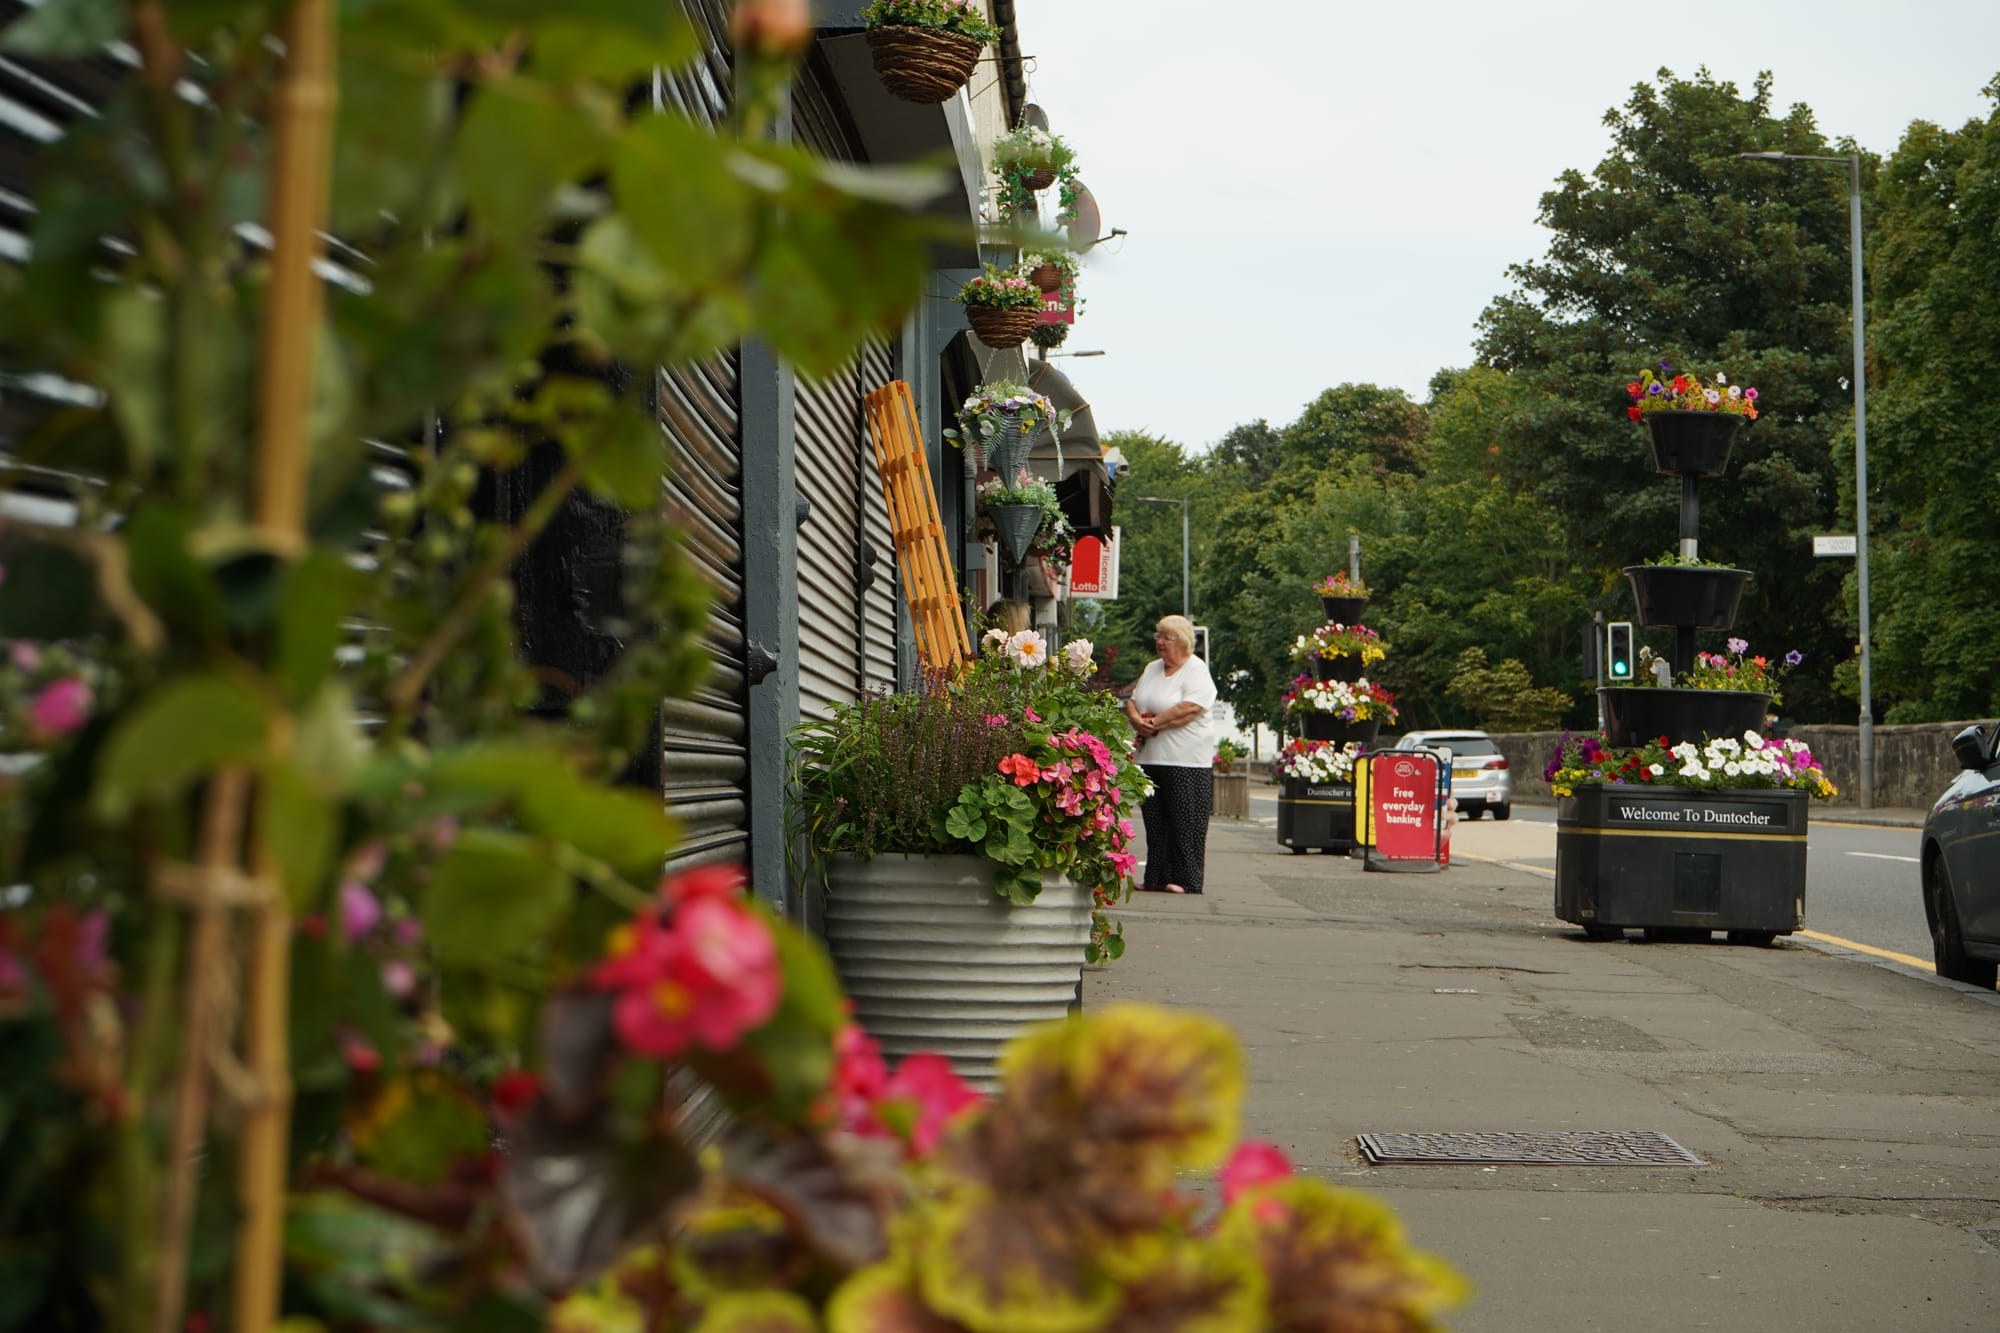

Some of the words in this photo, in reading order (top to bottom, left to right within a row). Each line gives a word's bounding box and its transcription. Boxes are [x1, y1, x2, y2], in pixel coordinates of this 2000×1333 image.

[1101, 555, 1110, 591] licence
[1072, 581, 1098, 591] Lotto
[1307, 788, 1345, 797] Duntocher
[1393, 787, 1414, 798] Free
[1382, 800, 1425, 815] everyday
[1386, 812, 1422, 827] banking
[1620, 806, 1681, 821] Welcome
[1683, 808, 1700, 822] To
[1703, 809, 1770, 825] Duntocher
